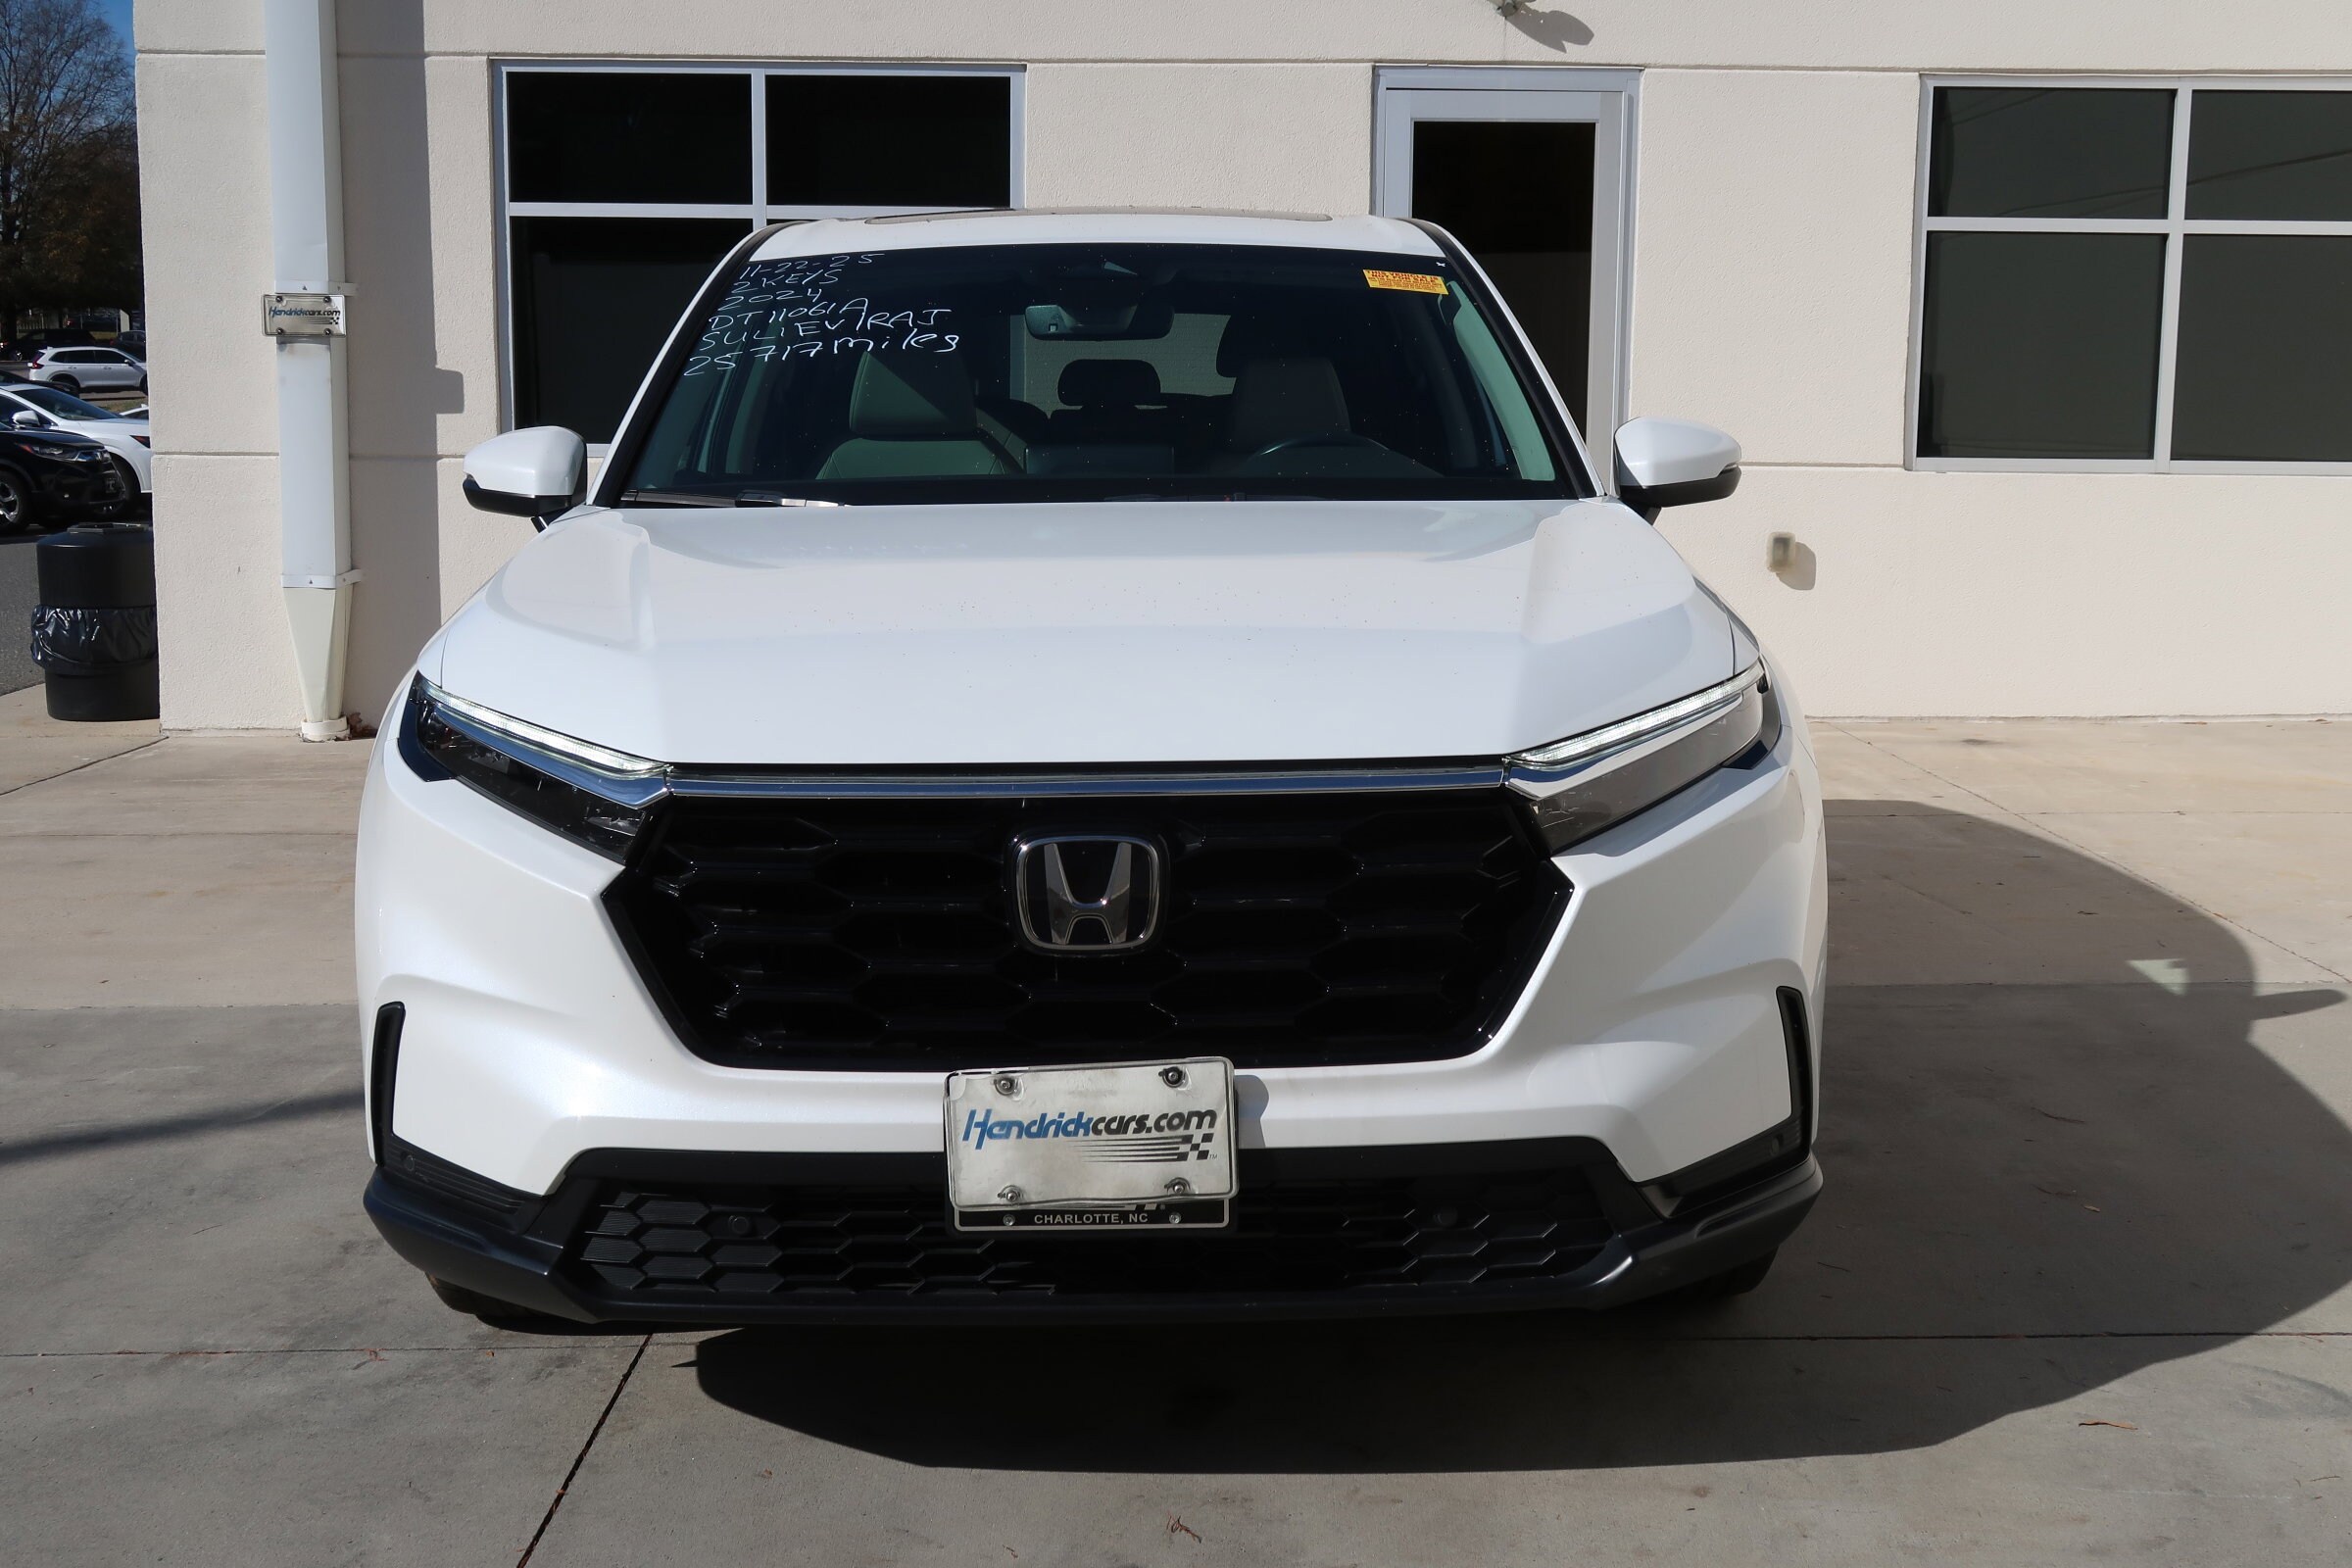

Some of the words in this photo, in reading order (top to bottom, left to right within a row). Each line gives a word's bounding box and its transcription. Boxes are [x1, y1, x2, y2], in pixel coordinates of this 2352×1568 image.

[739, 253, 885, 279] 11-22-25
[731, 280, 759, 294] 2
[761, 269, 843, 288] KEYS
[717, 288, 822, 311] 2024
[962, 1108, 1218, 1151] Hendrickcars.com
[1034, 1213, 1124, 1225] CHARLOTTE,
[1129, 1212, 1149, 1223] NC
